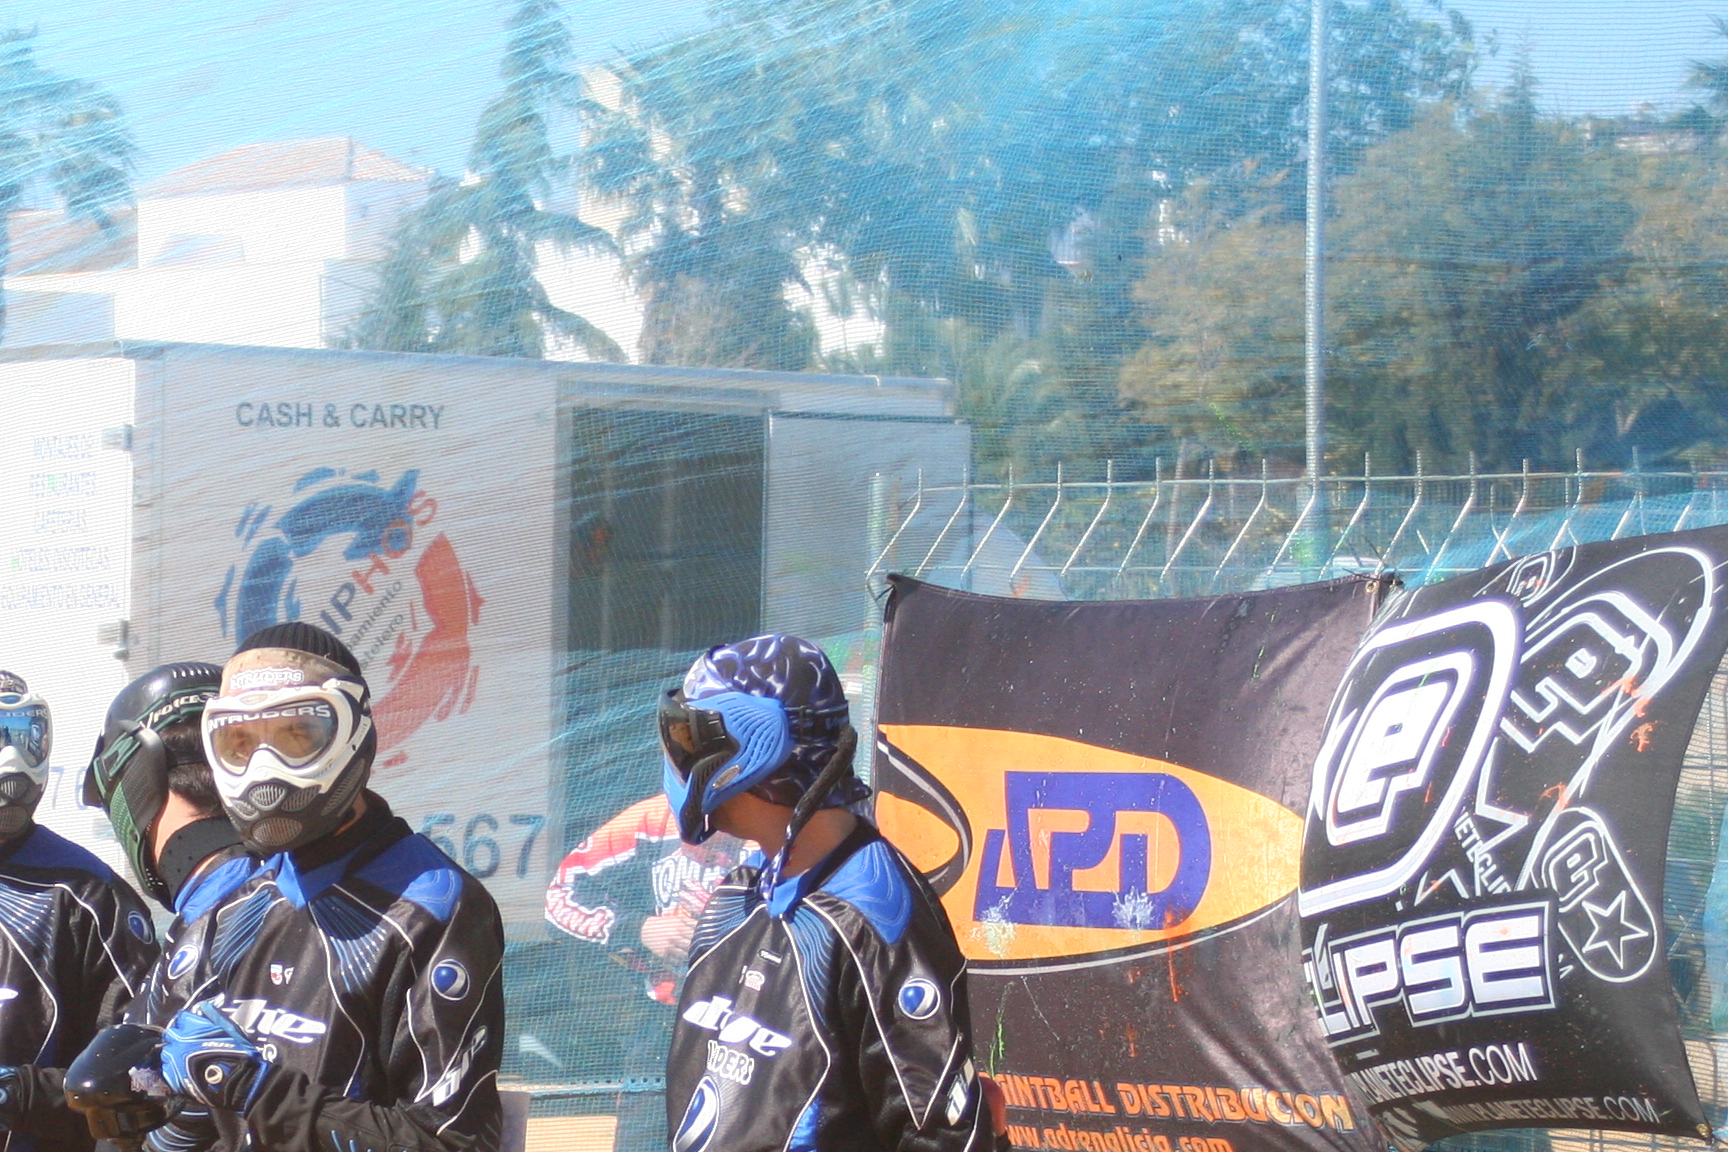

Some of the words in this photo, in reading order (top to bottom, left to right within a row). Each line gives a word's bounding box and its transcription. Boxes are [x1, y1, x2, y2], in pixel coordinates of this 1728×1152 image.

[236, 402, 313, 428] CASH
[323, 402, 342, 428] &
[350, 402, 445, 429] CARRY
[320, 490, 438, 635] IPHOS
[1117, 1082, 1356, 1132] DISTRIBUCION
